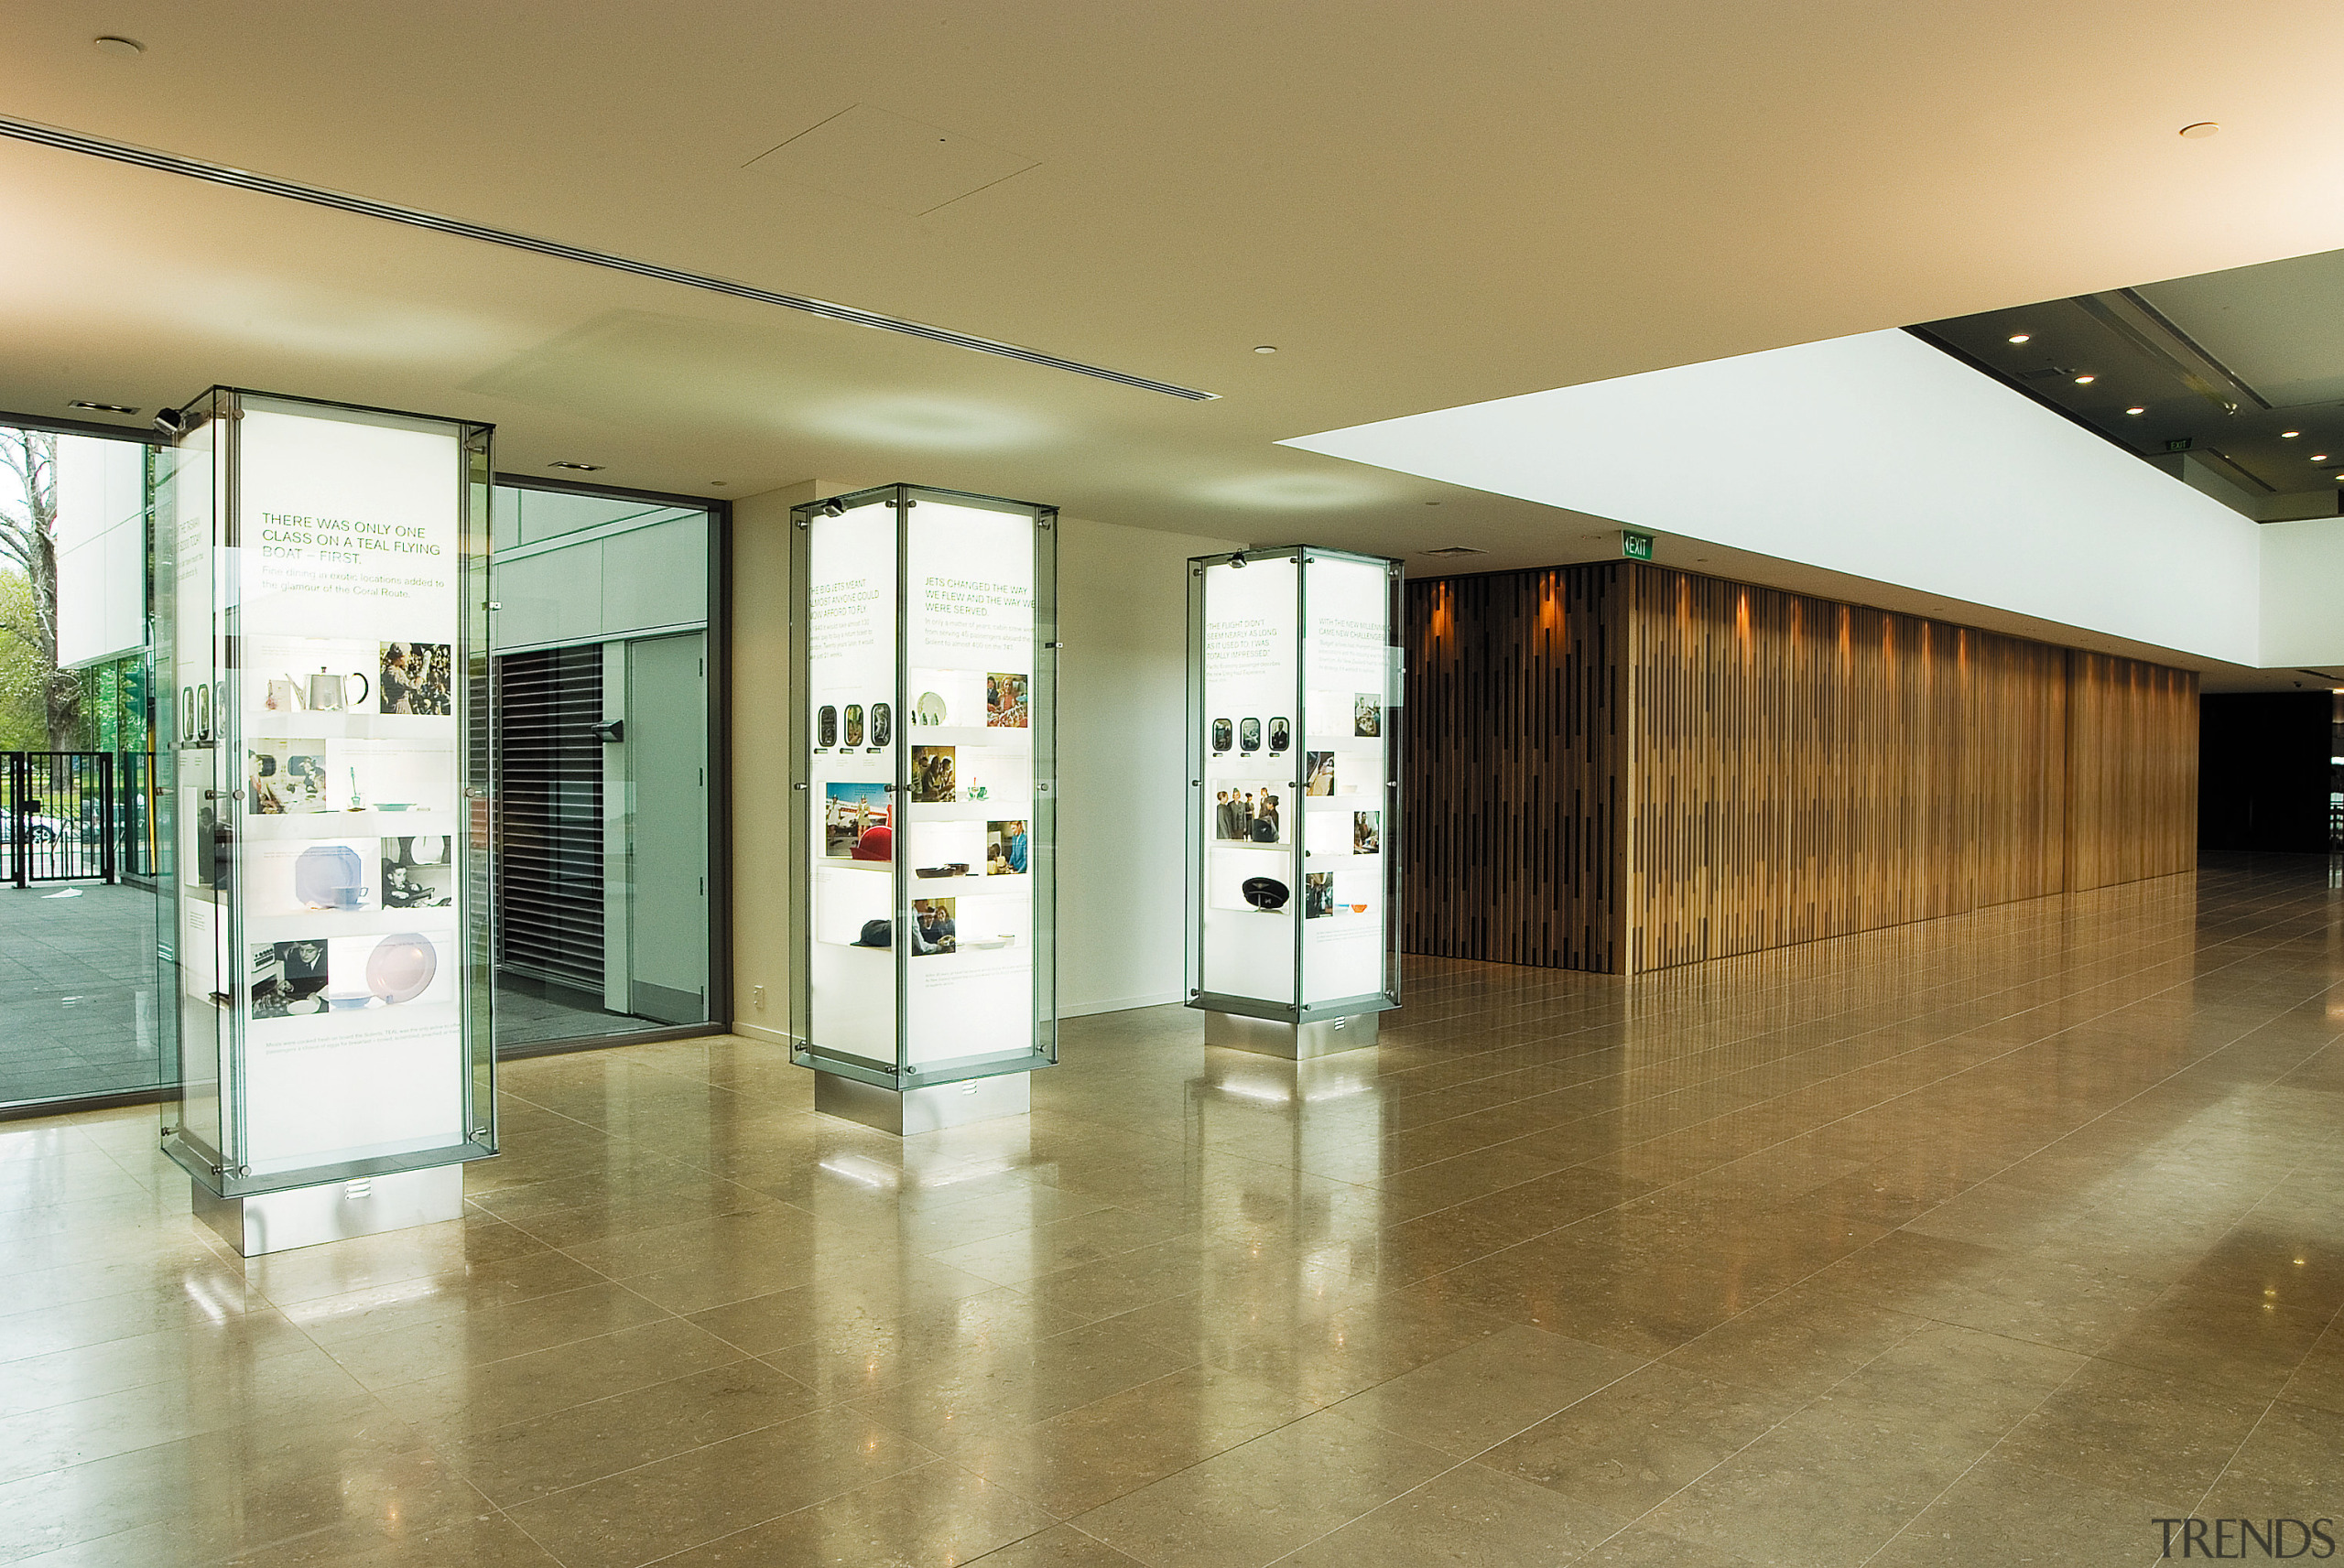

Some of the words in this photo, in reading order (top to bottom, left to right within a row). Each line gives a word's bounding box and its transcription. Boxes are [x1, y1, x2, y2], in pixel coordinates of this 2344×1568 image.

[2170, 440, 2186, 449] EXIT
[262, 513, 312, 528] THERE
[317, 518, 350, 532] WAS
[354, 521, 391, 535] ONLY
[395, 525, 426, 539] ONE
[262, 529, 312, 544] CLASS
[317, 534, 339, 546] ON
[343, 537, 353, 547] A
[357, 537, 390, 551] TEAL
[394, 541, 440, 556] FLYING
[1630, 536, 1647, 557] EXIT
[262, 546, 303, 559] BOAT
[320, 550, 362, 565] FIRST.
[286, 568, 316, 579] dining
[320, 570, 328, 579] in
[331, 573, 358, 582] exotic
[361, 573, 402, 585] locations
[404, 577, 433, 588] added
[436, 579, 445, 589] to
[925, 577, 945, 587] JETS
[947, 579, 991, 591] CHANGED
[993, 583, 1008, 593] THE
[1010, 586, 1027, 595] WAY
[262, 580, 277, 589] the
[281, 581, 320, 592] glamour
[323, 584, 332, 592] of
[335, 584, 350, 594] the
[353, 586, 378, 597] Coral
[857, 589, 880, 600] COULD
[925, 589, 939, 600] WE
[941, 590, 965, 601] FLEW
[967, 594, 984, 604] AND
[986, 595, 1002, 606] THE
[1004, 598, 1021, 606] WAY
[824, 607, 847, 617] AFFORD
[848, 605, 856, 615] TO
[925, 602, 951, 613] WERE
[953, 605, 990, 617] SERVED.
